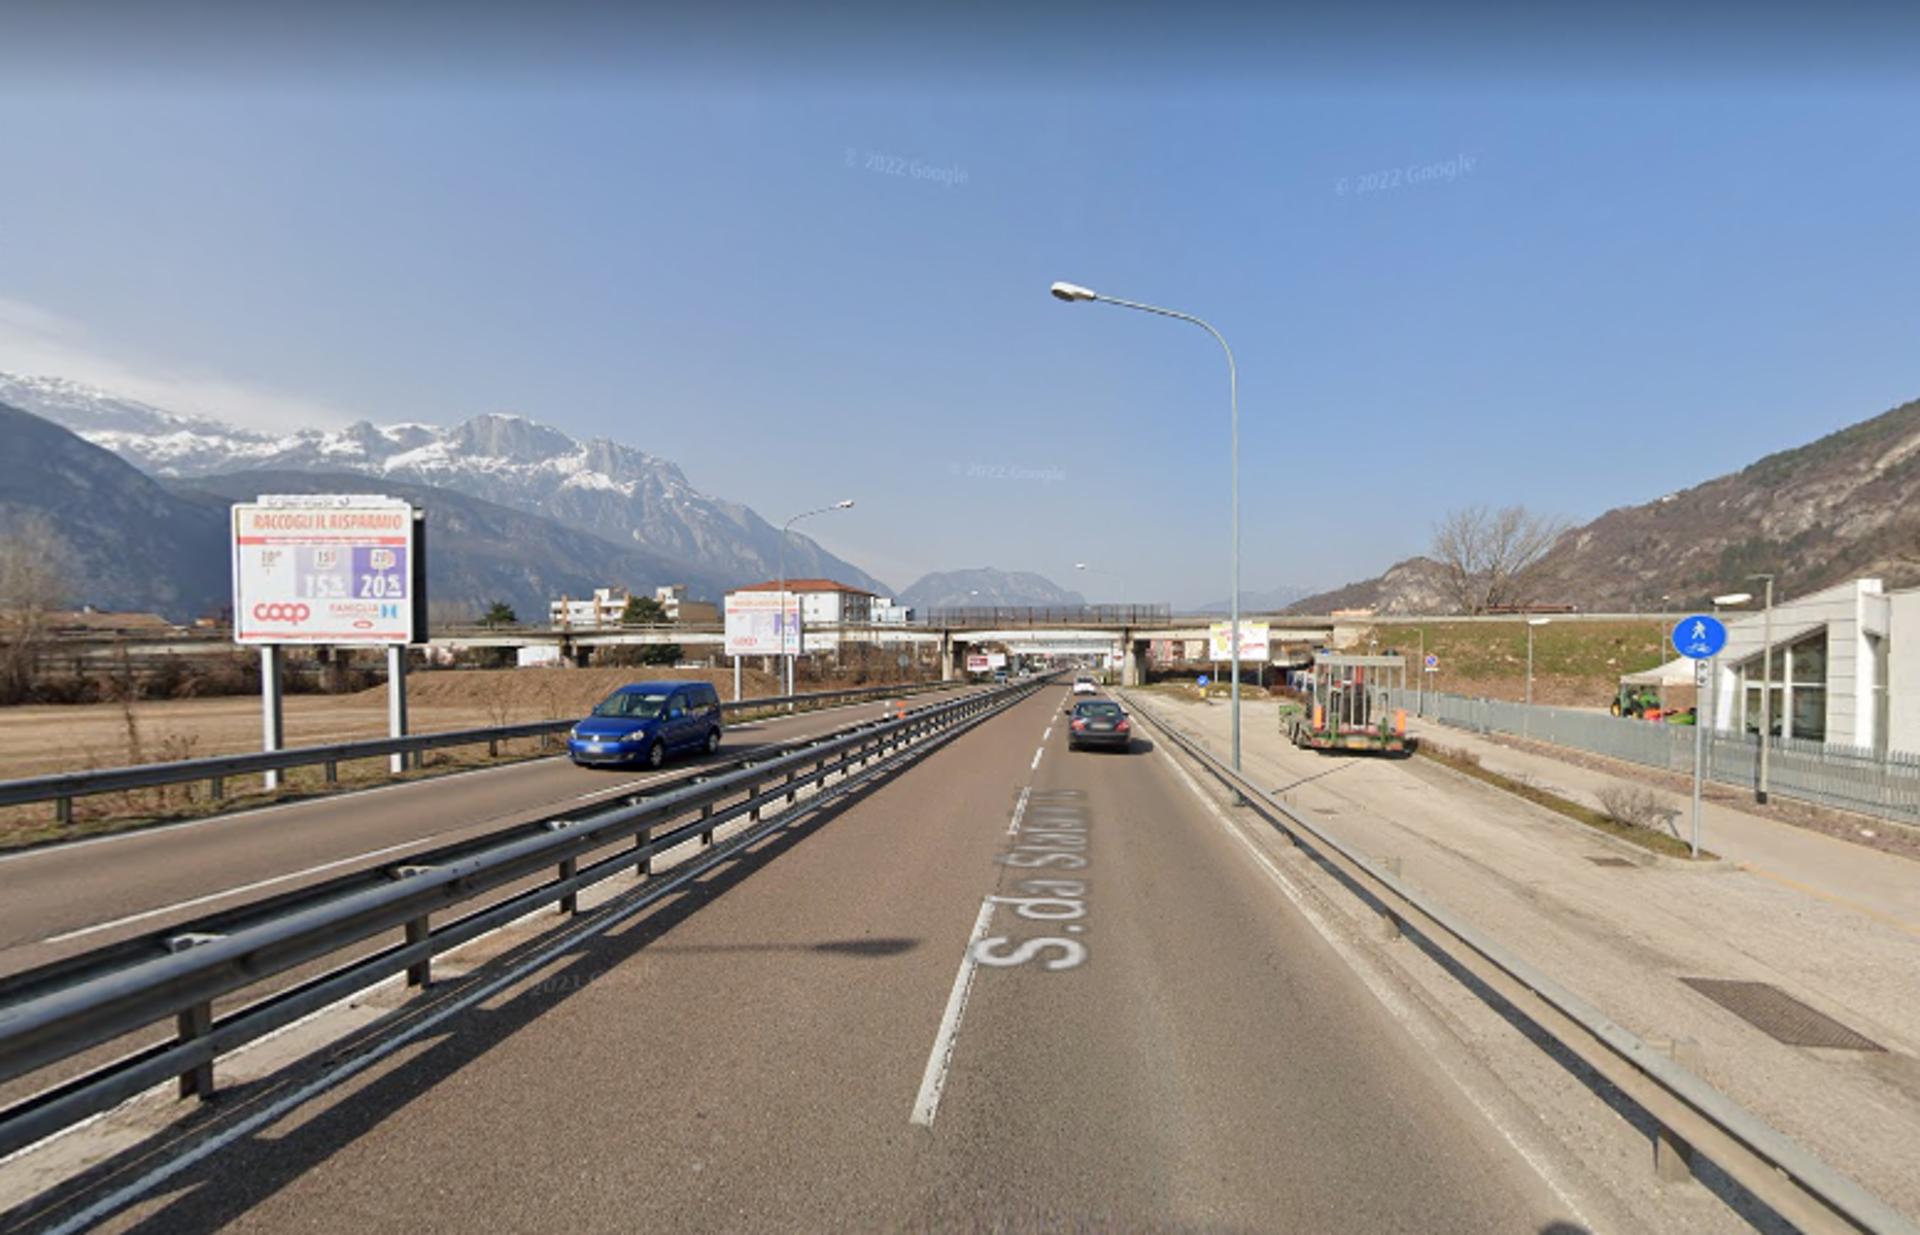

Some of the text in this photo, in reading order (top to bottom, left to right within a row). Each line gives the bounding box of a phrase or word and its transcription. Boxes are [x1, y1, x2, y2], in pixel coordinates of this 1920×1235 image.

[254, 514, 403, 530] RACCOGLI IL RISPARMIO
